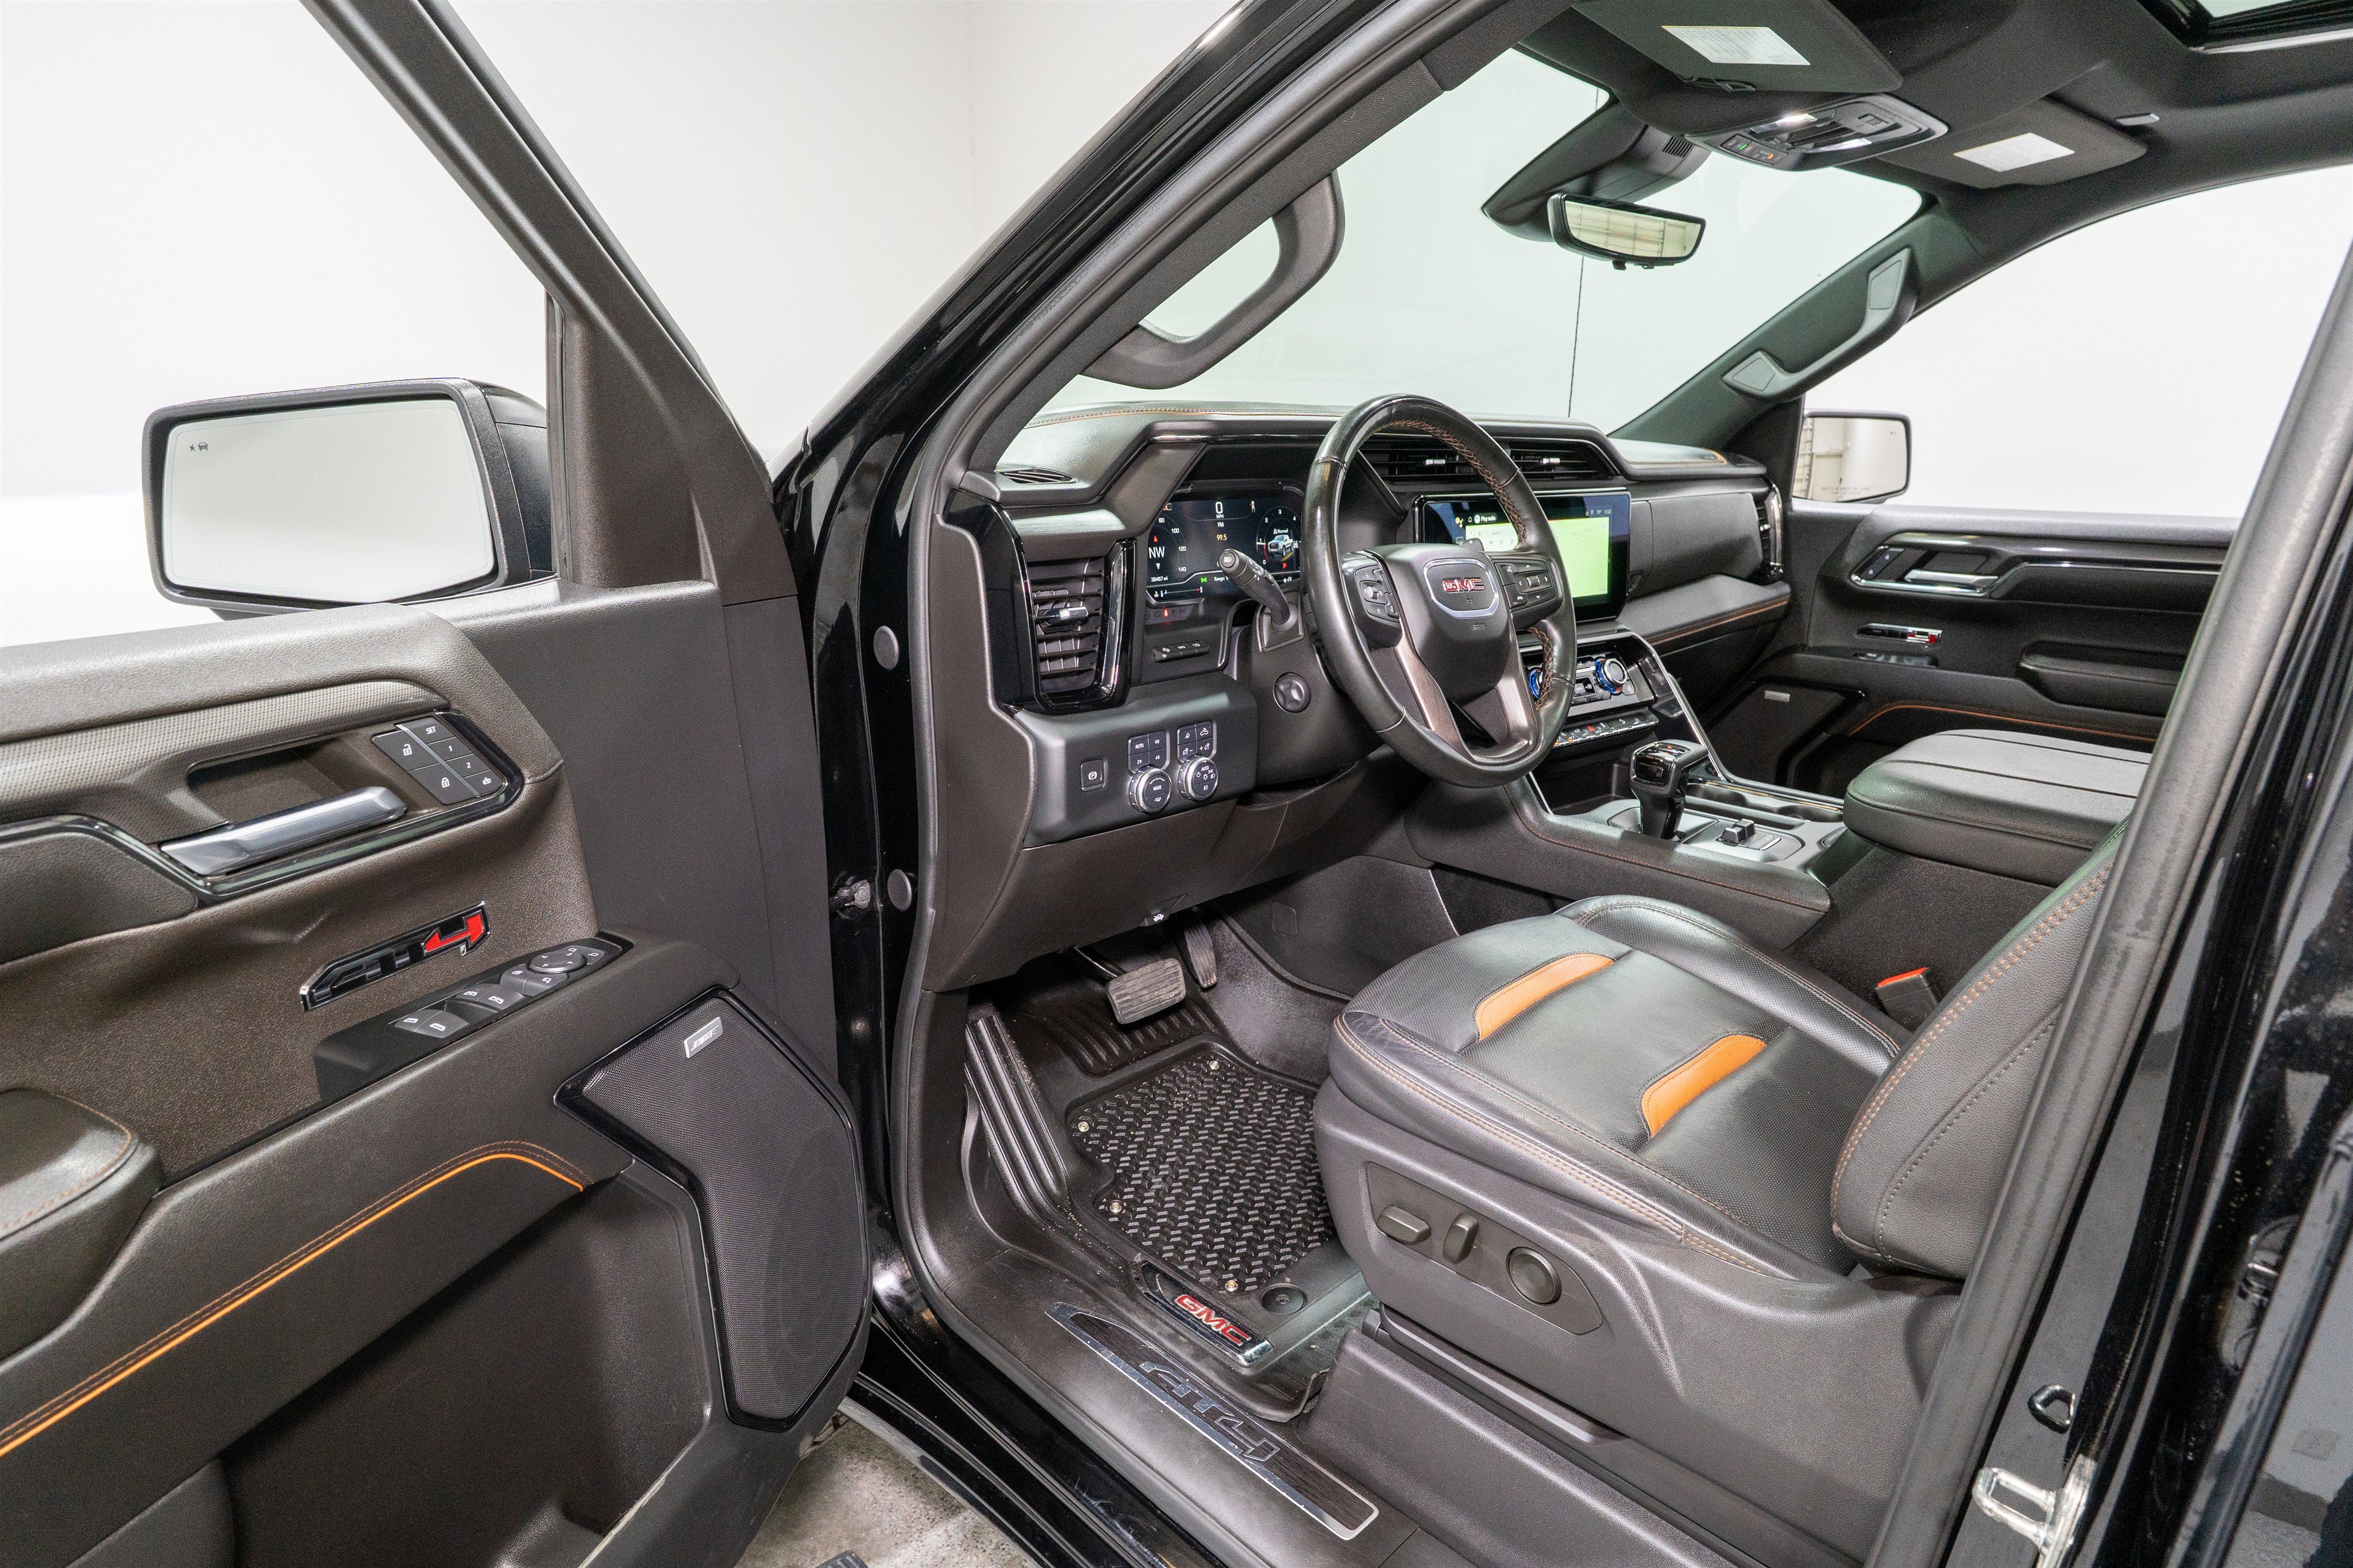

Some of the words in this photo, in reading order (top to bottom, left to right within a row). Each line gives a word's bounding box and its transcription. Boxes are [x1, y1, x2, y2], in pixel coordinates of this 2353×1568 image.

[1215, 501, 1223, 514] 0
[1148, 546, 1165, 558] NW
[1442, 577, 1485, 593] GMC
[426, 726, 436, 735] SET
[1176, 1294, 1252, 1346] GMC
[1139, 1361, 1280, 1462] AT4
